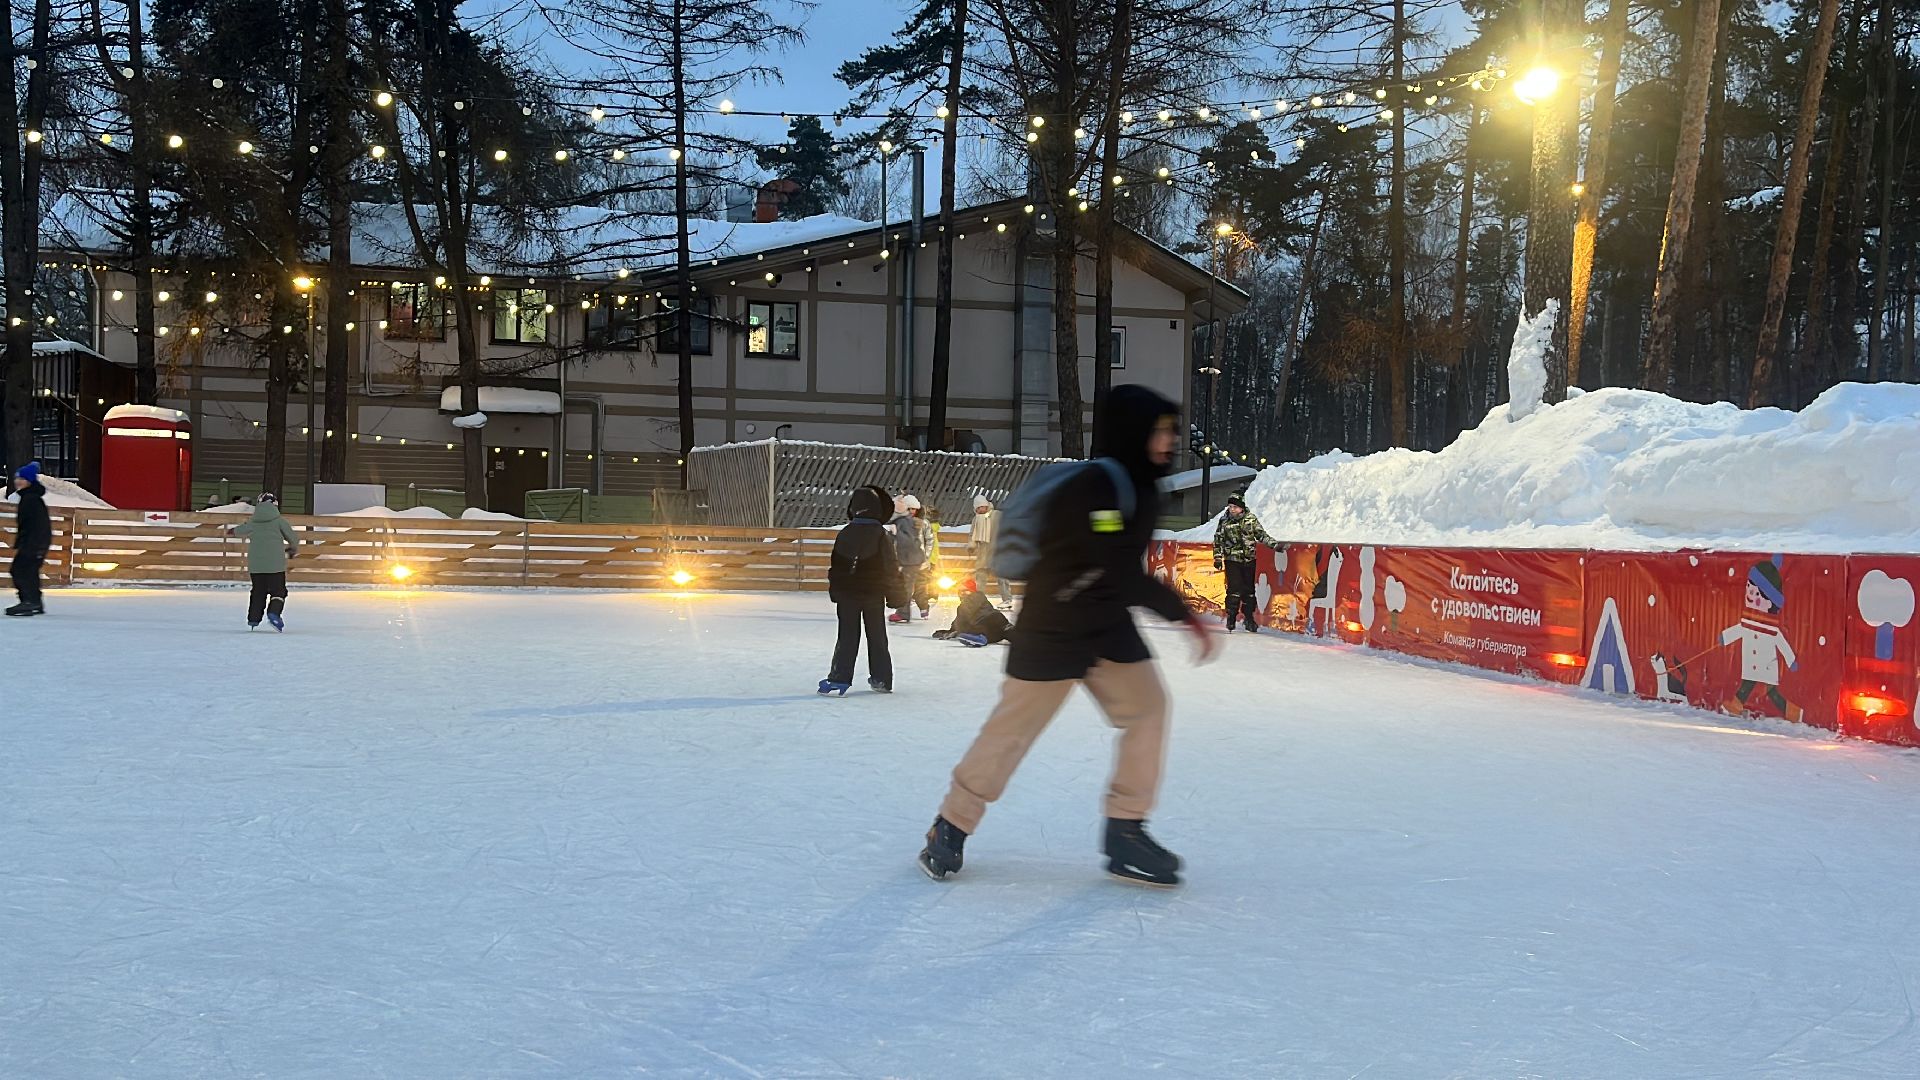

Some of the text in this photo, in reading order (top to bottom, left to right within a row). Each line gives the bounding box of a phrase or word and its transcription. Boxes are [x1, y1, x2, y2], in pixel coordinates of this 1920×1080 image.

[1450, 566, 1519, 595] Катайтесь
[1431, 597, 1541, 627] с удовольствием
[1443, 631, 1527, 658] Команда губернатора
